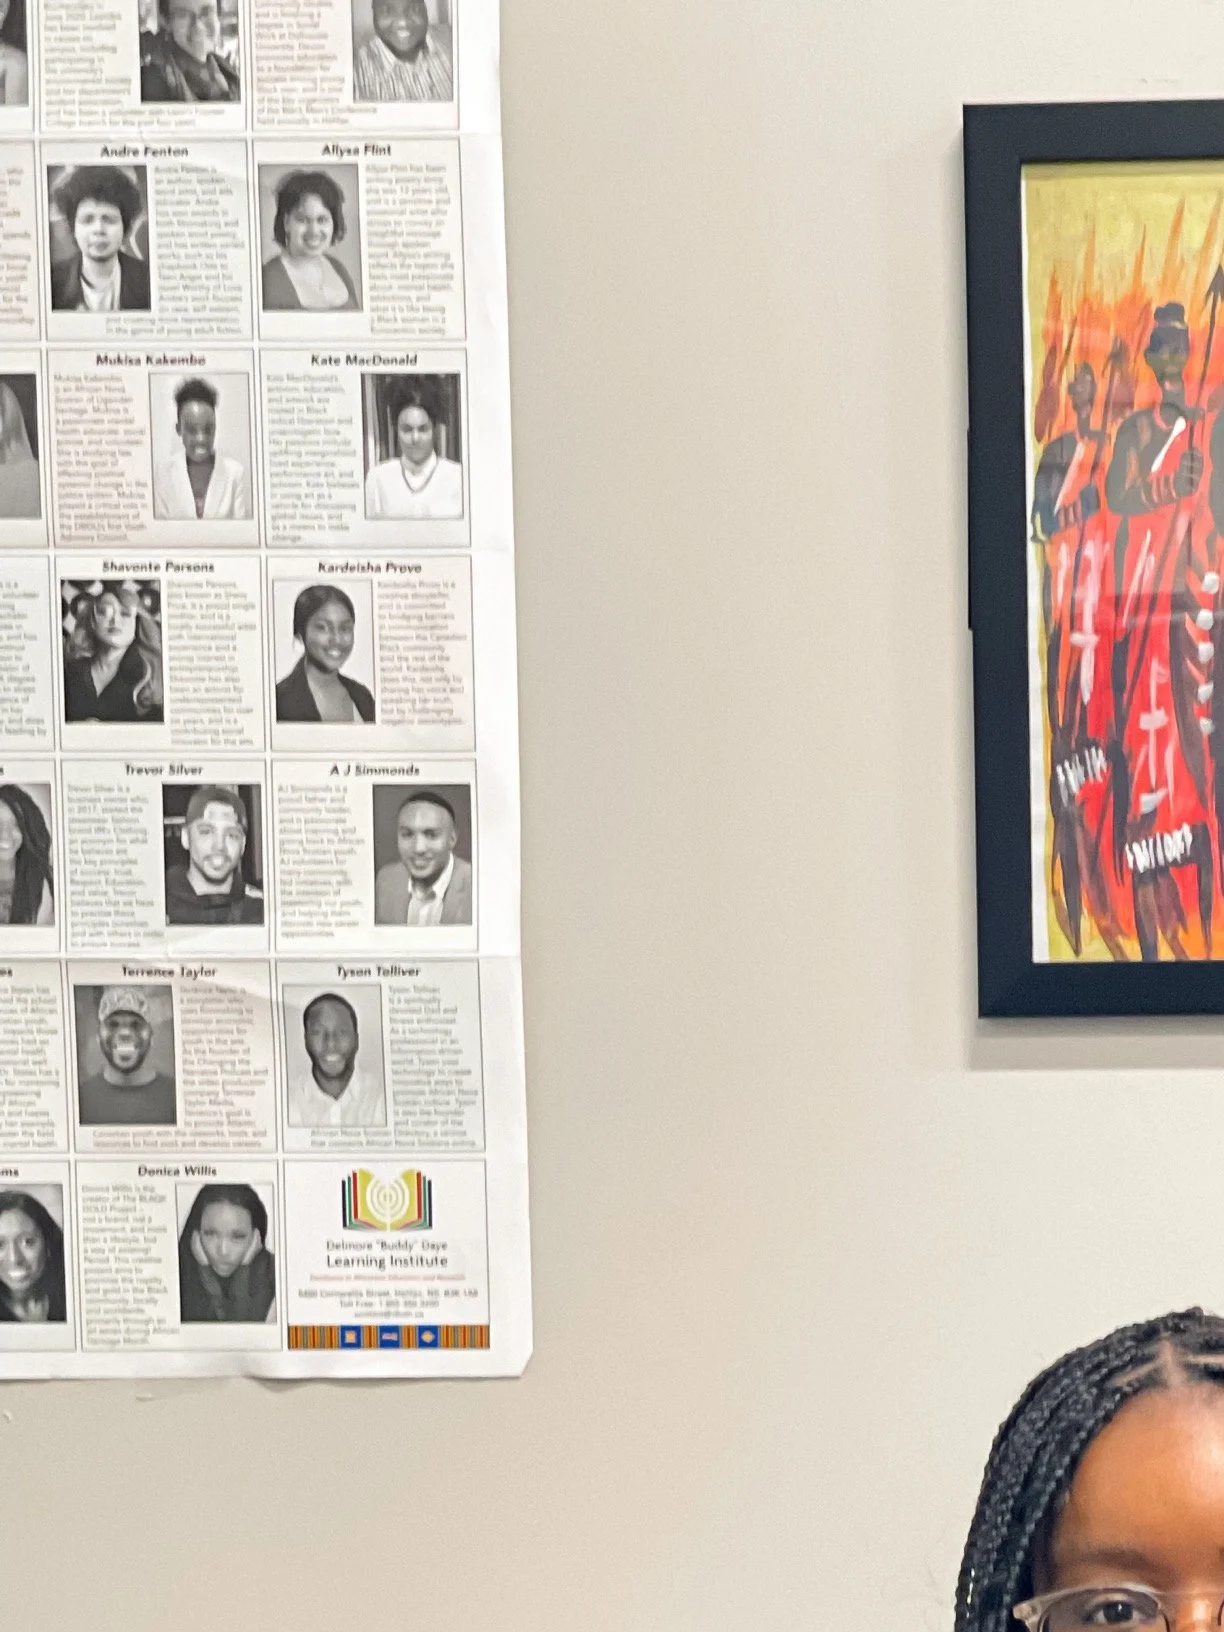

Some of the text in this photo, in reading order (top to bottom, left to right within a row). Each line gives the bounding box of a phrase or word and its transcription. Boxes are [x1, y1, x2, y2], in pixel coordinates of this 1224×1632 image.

[100, 144, 188, 158] Andre Fenton
[321, 144, 392, 158] Allysa Flint
[96, 355, 206, 366] Mukisa Kakembo
[311, 354, 417, 366] Kate MacDonald
[103, 560, 215, 572] Shavonte Parsons
[318, 562, 422, 573] Kardeisha Prove
[126, 764, 203, 775] Trevor Silver
[330, 764, 420, 776] A J Simmonds
[122, 967, 217, 979] Terrence Taylor
[337, 967, 420, 979] Tyson Tolliver
[185, 1166, 217, 1176] Willis
[326, 1239, 447, 1252] Delmore "Buddy" Daye
[327, 1256, 448, 1271] Learning Institute
